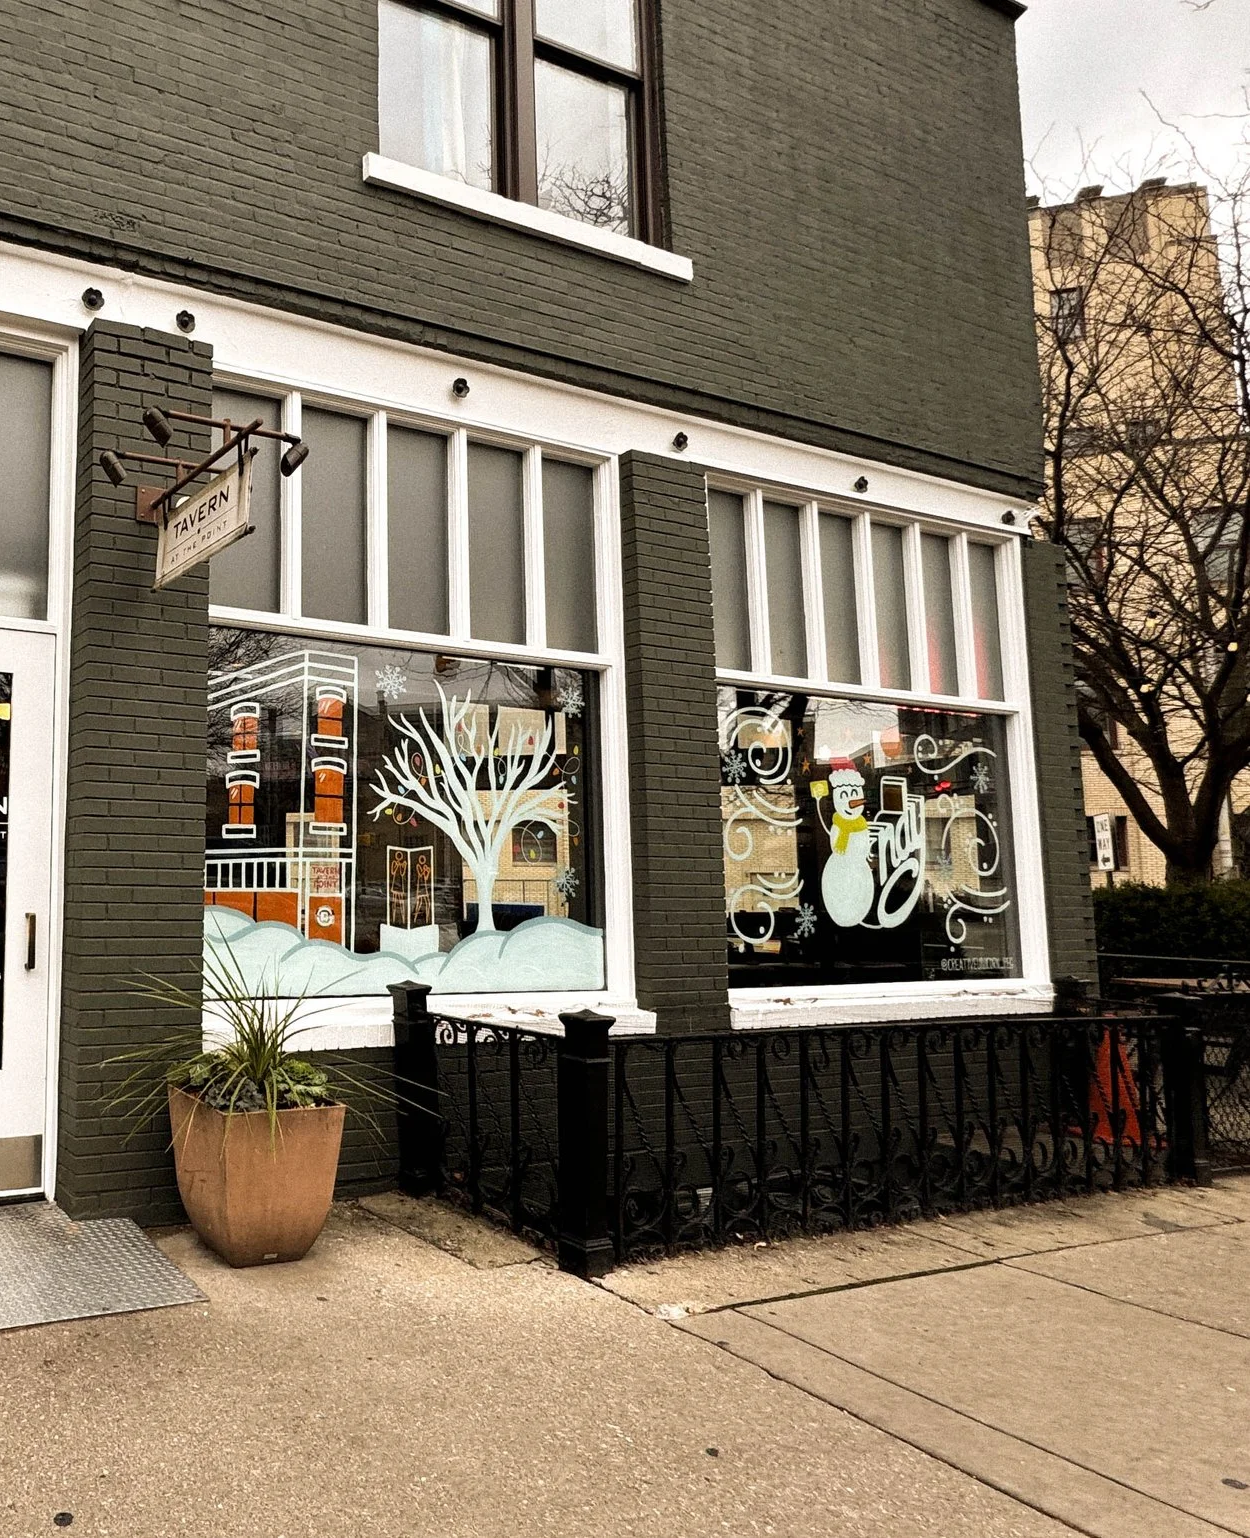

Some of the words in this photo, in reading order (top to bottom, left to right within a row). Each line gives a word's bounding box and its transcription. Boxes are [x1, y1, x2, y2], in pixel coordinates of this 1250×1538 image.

[174, 485, 229, 539] TAVERN
[171, 553, 179, 564] AT
[183, 541, 197, 556] THE
[201, 520, 227, 543] POINT
[1096, 819, 1109, 833] ONE
[1098, 838, 1110, 850] WAY
